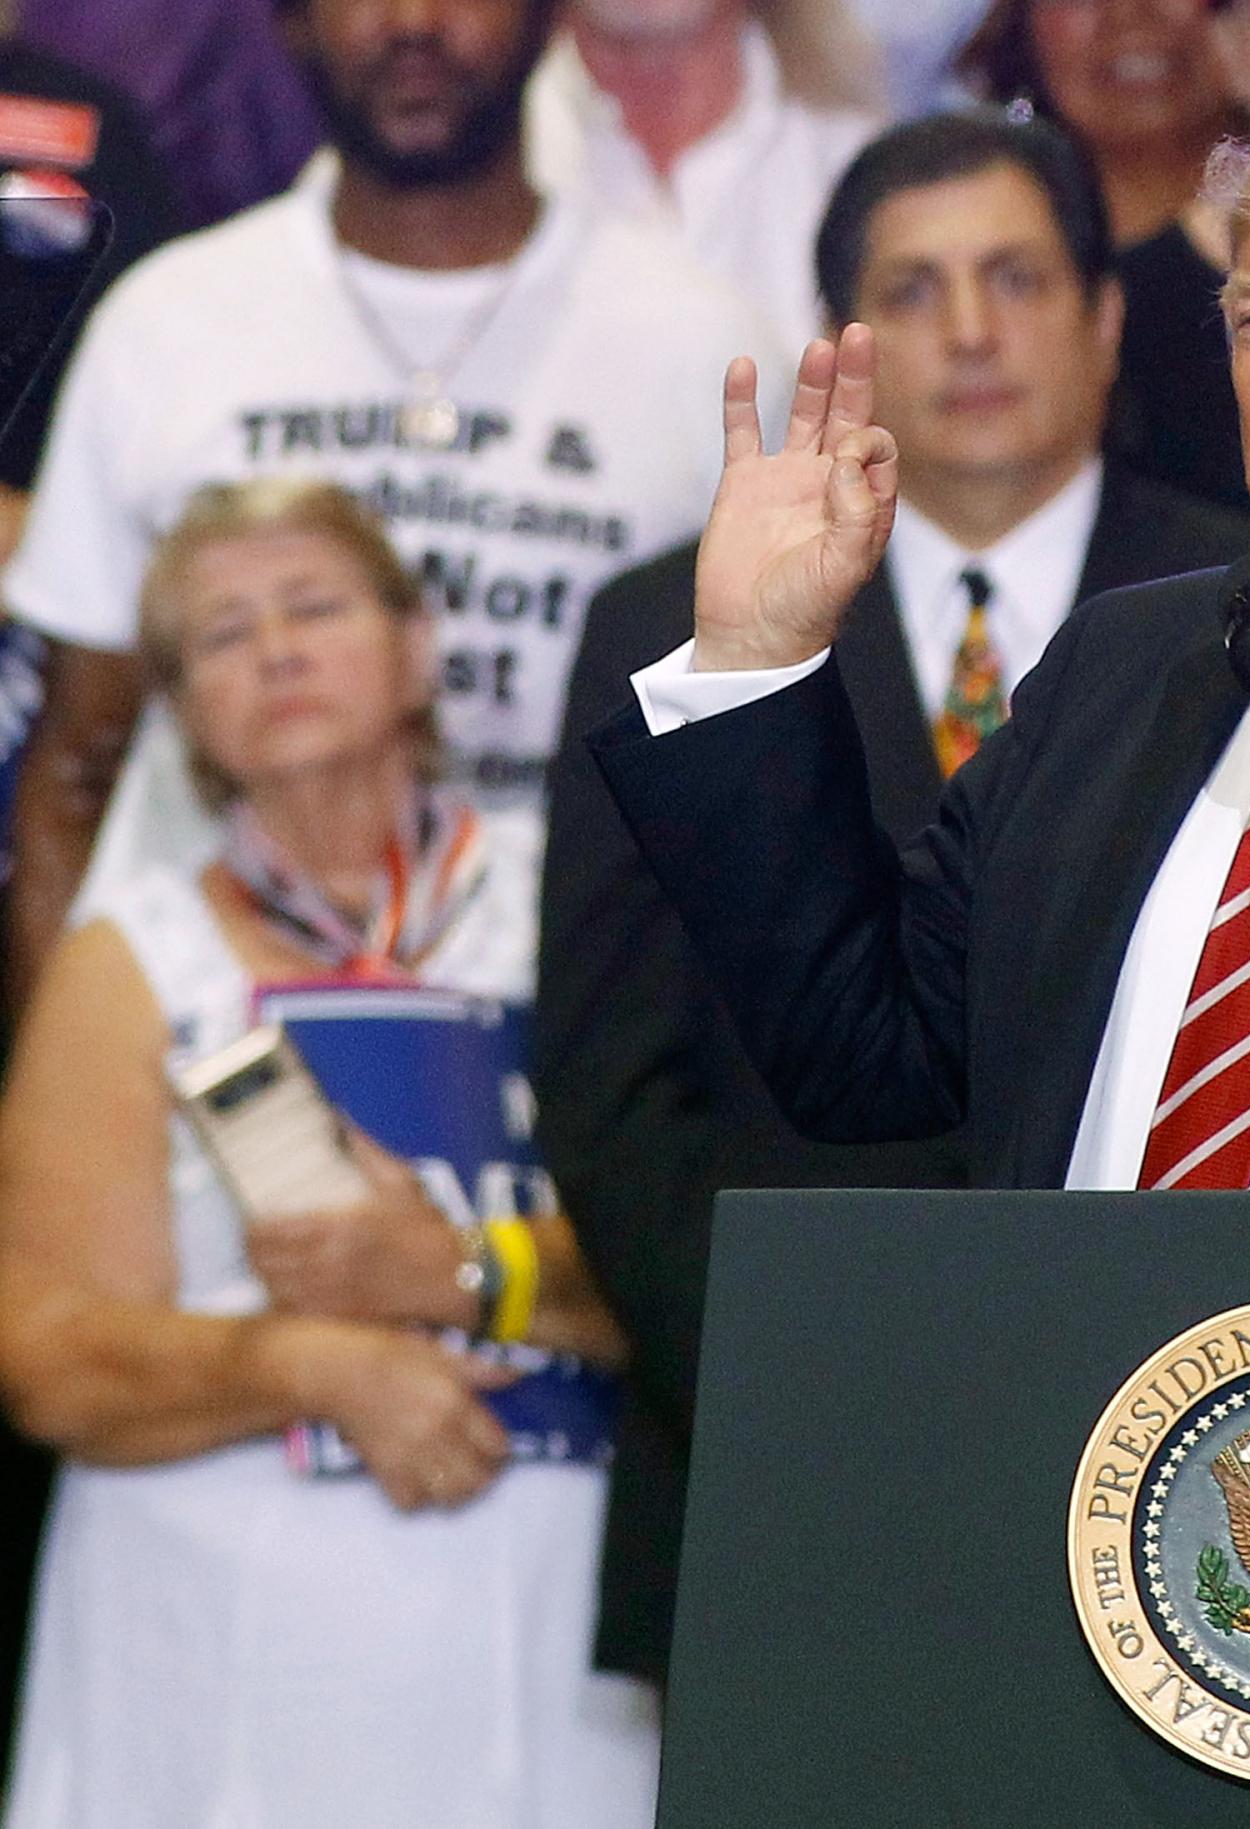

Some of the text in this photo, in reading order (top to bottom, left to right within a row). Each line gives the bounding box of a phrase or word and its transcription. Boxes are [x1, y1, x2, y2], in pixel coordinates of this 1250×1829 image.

[362, 470, 627, 551] blicans
[1092, 1544, 1125, 1610] THE
[1107, 1616, 1145, 1660] OF
